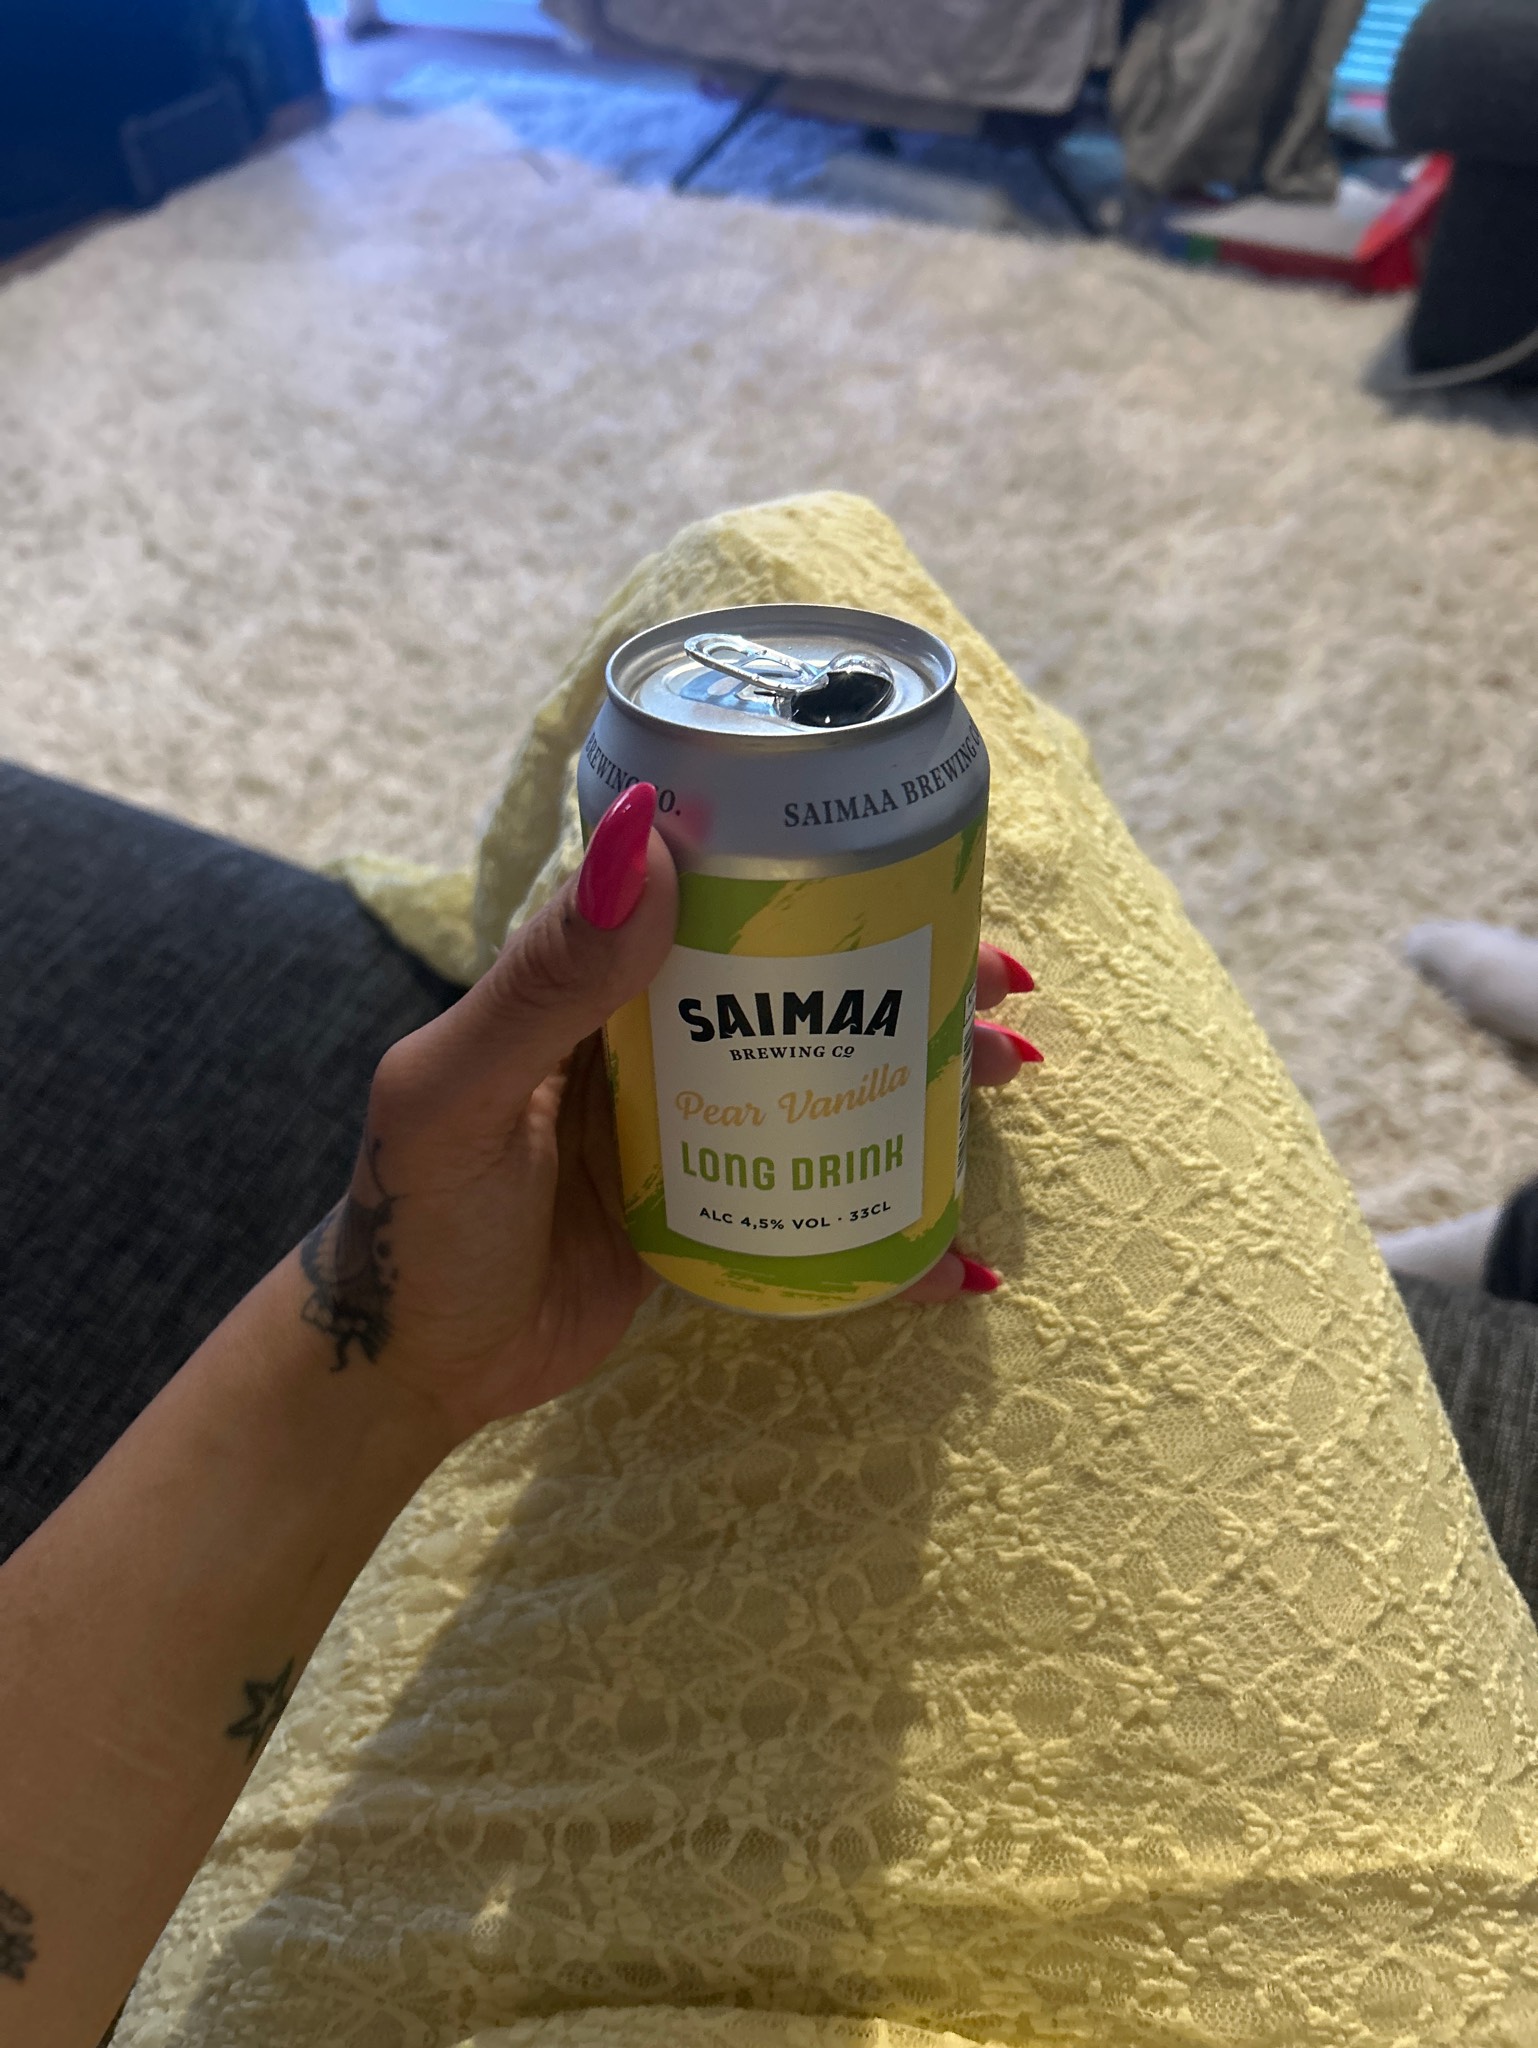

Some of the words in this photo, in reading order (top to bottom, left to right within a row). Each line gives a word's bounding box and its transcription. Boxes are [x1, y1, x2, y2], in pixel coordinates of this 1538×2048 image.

[655, 785, 681, 816] O.
[784, 788, 899, 828] SAIMAA
[901, 736, 977, 805] BREWING
[678, 989, 902, 1042] SAIMAA
[729, 1046, 825, 1061] BREWING
[675, 1090, 766, 1127] Pear
[777, 1063, 911, 1124] Vanilla
[681, 1141, 775, 1191] LONG
[792, 1134, 903, 1191] DRINK
[700, 1207, 733, 1224] ALC
[740, 1217, 785, 1230] 4,5%
[792, 1217, 831, 1229] VOL
[849, 1201, 891, 1222] 33CL
